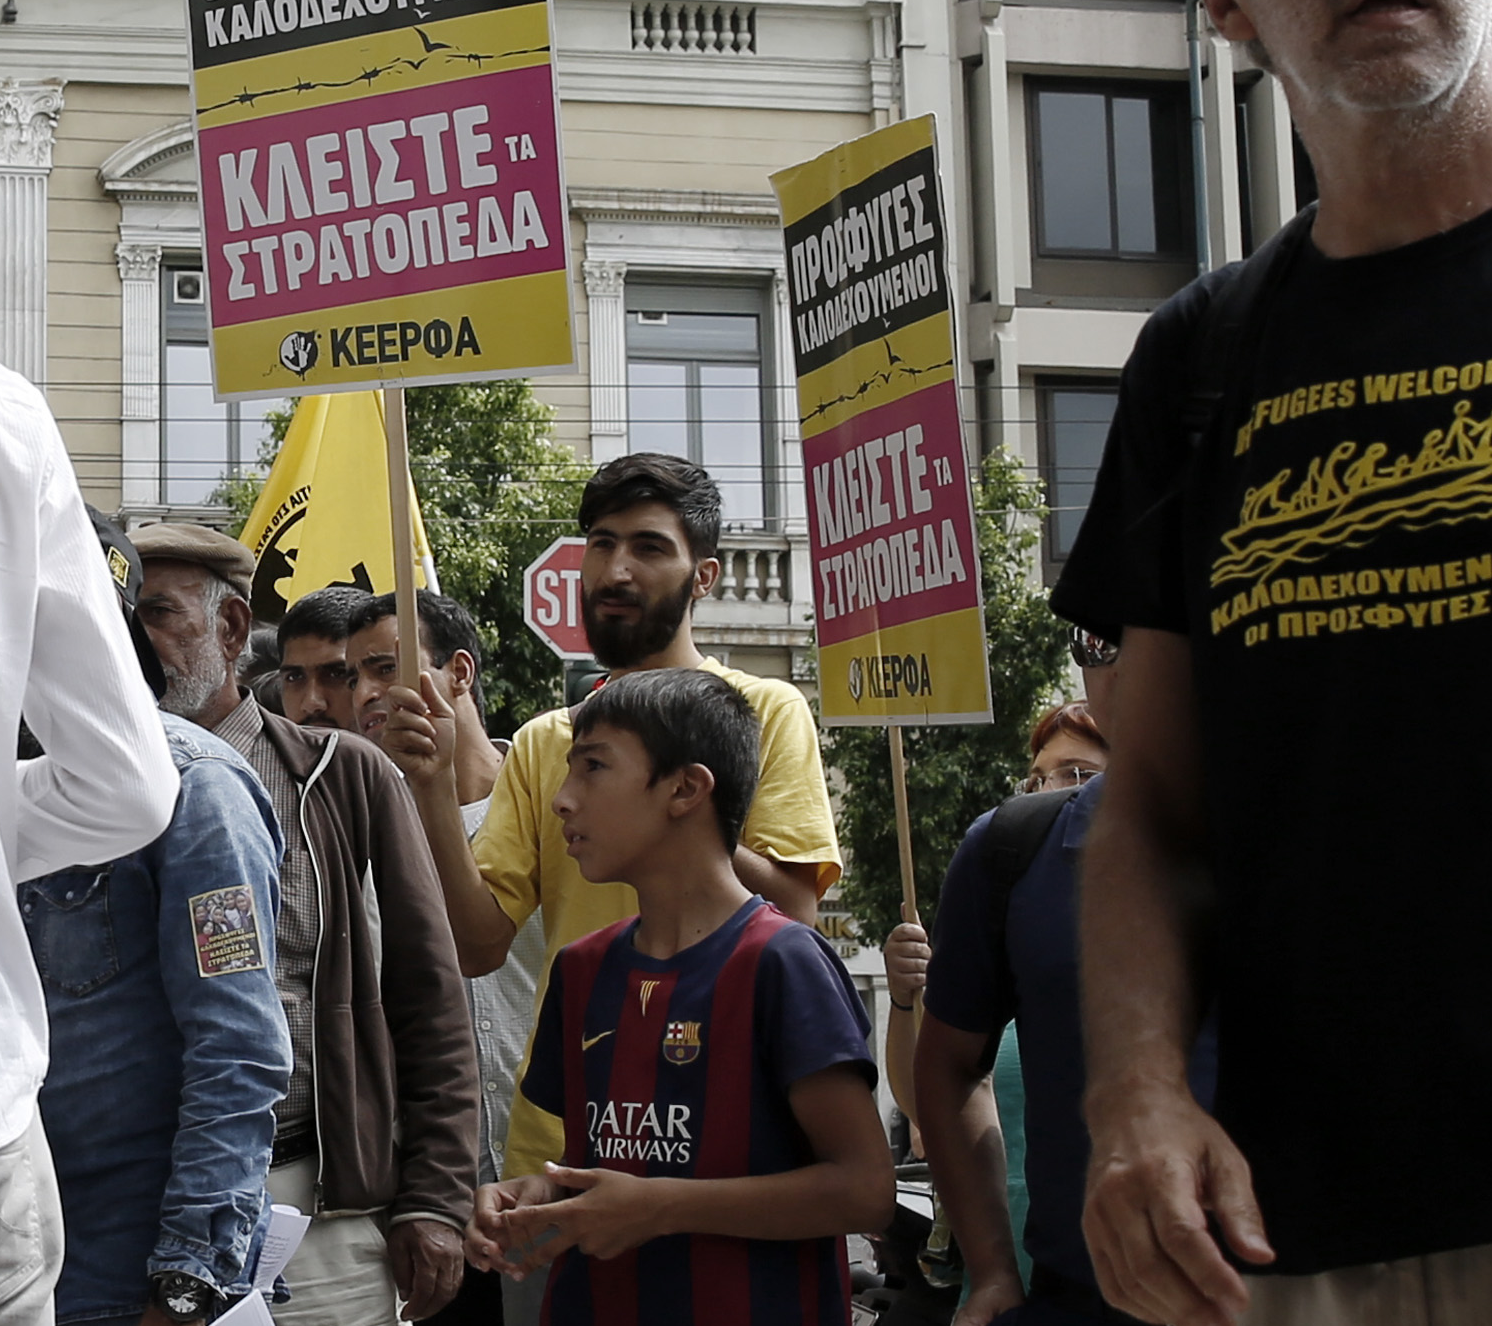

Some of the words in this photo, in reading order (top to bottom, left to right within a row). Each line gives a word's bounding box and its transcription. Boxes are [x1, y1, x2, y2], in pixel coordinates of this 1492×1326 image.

[218, 103, 498, 232] ΚΛΕΙΣΤΕ
[504, 132, 537, 164] ΤΑ
[222, 189, 551, 302] ΣΤΡΑΤΟΠΕΔΑ
[791, 174, 935, 306] ΠΡΟΣΦΥΓΕΣ
[329, 316, 482, 368] ΚΕΕΡΦΑ
[797, 248, 939, 356] ΚΑΛΟΔΕΧΟΥΜΕΝΟΙ
[811, 423, 933, 549] ΚΛΕΙΣΤΕ
[933, 456, 953, 489] ΤΑ
[537, 569, 581, 627] ST
[820, 519, 967, 623] ΣΤΡΑΤΟΠΕΔΑ
[1277, 589, 1492, 639] ΠΡΟΣΦΥΓΕΣ
[866, 652, 933, 700] ΚΕΕΡΦΑ
[586, 1100, 692, 1142] QATAR
[594, 1137, 691, 1164] AIRWAYS
